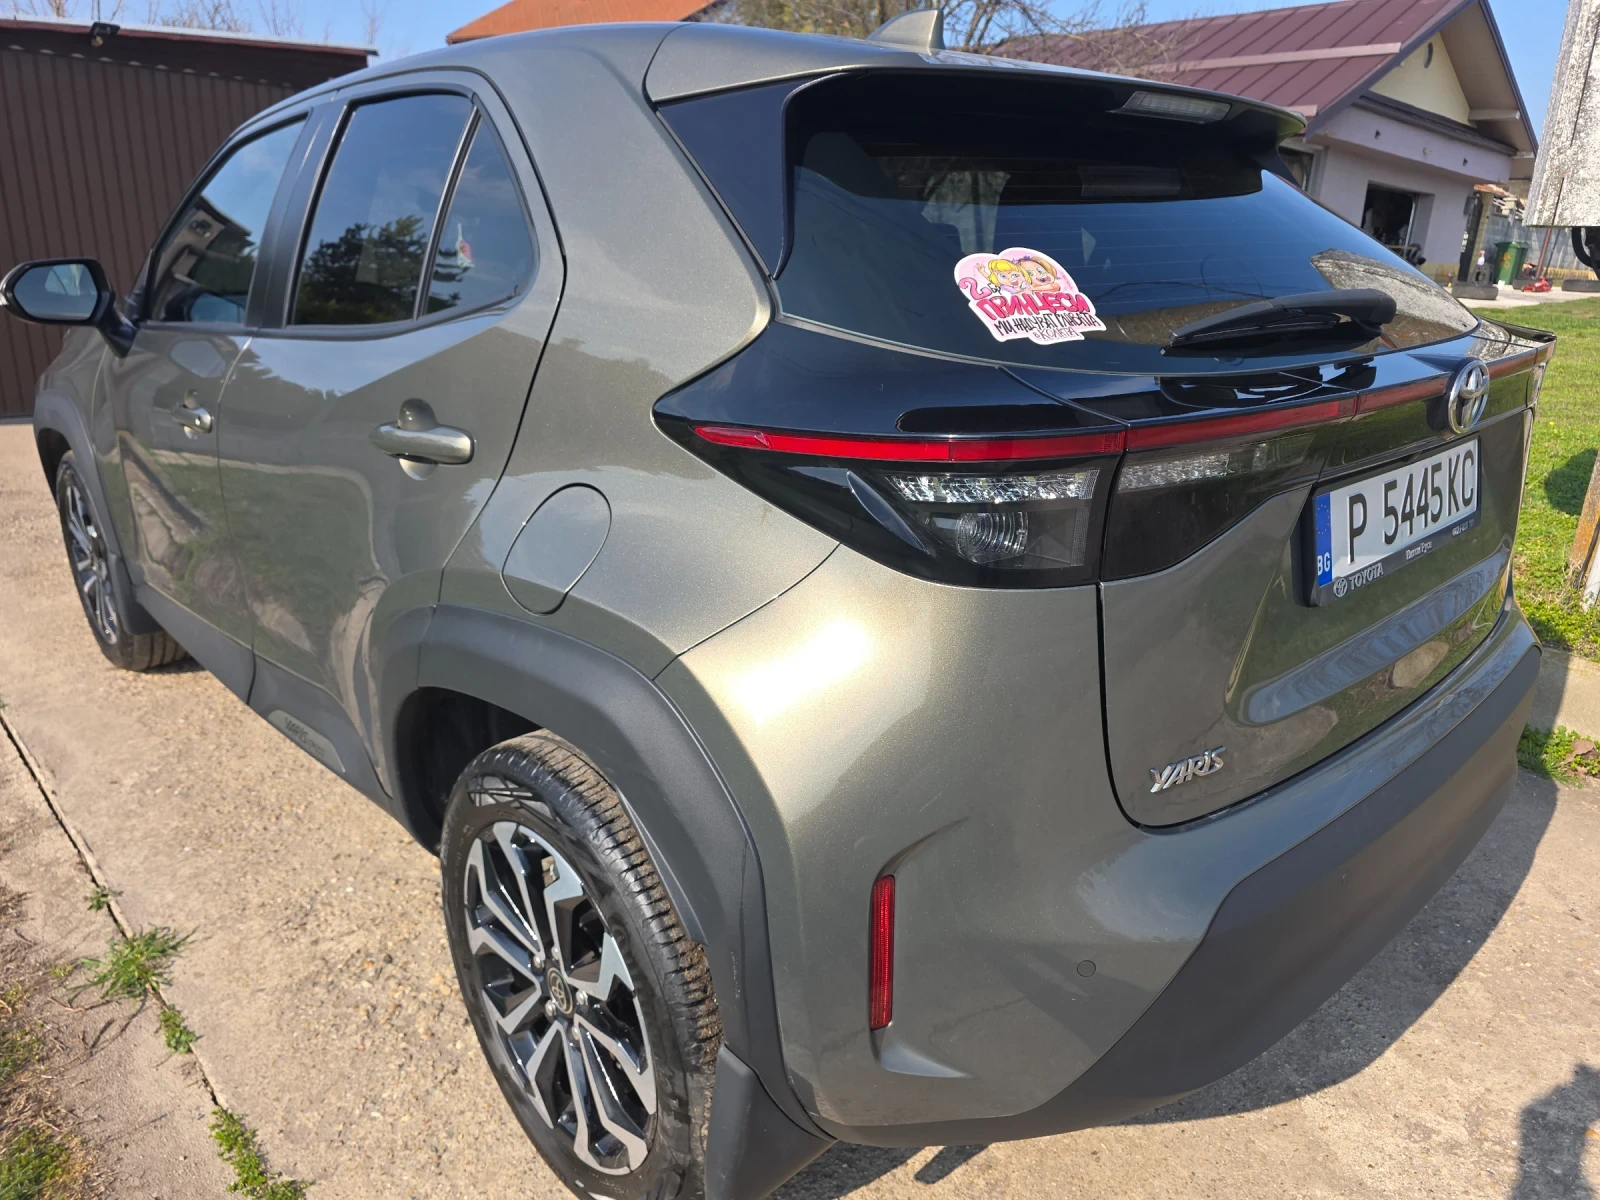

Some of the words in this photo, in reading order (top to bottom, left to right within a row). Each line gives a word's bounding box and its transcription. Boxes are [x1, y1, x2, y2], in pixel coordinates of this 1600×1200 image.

[958, 277, 992, 300] 2
[976, 292, 1090, 320] ПРИНЦЕСИ
[994, 317, 1017, 336] МИ
[1014, 313, 1055, 334] НАДУВАТ
[1054, 312, 1101, 328] ГЛАВАТА
[1348, 493, 1367, 565] P
[1317, 552, 1331, 575] BG
[1349, 563, 1384, 590] TOYOTA
[1149, 746, 1226, 793] YARIS
